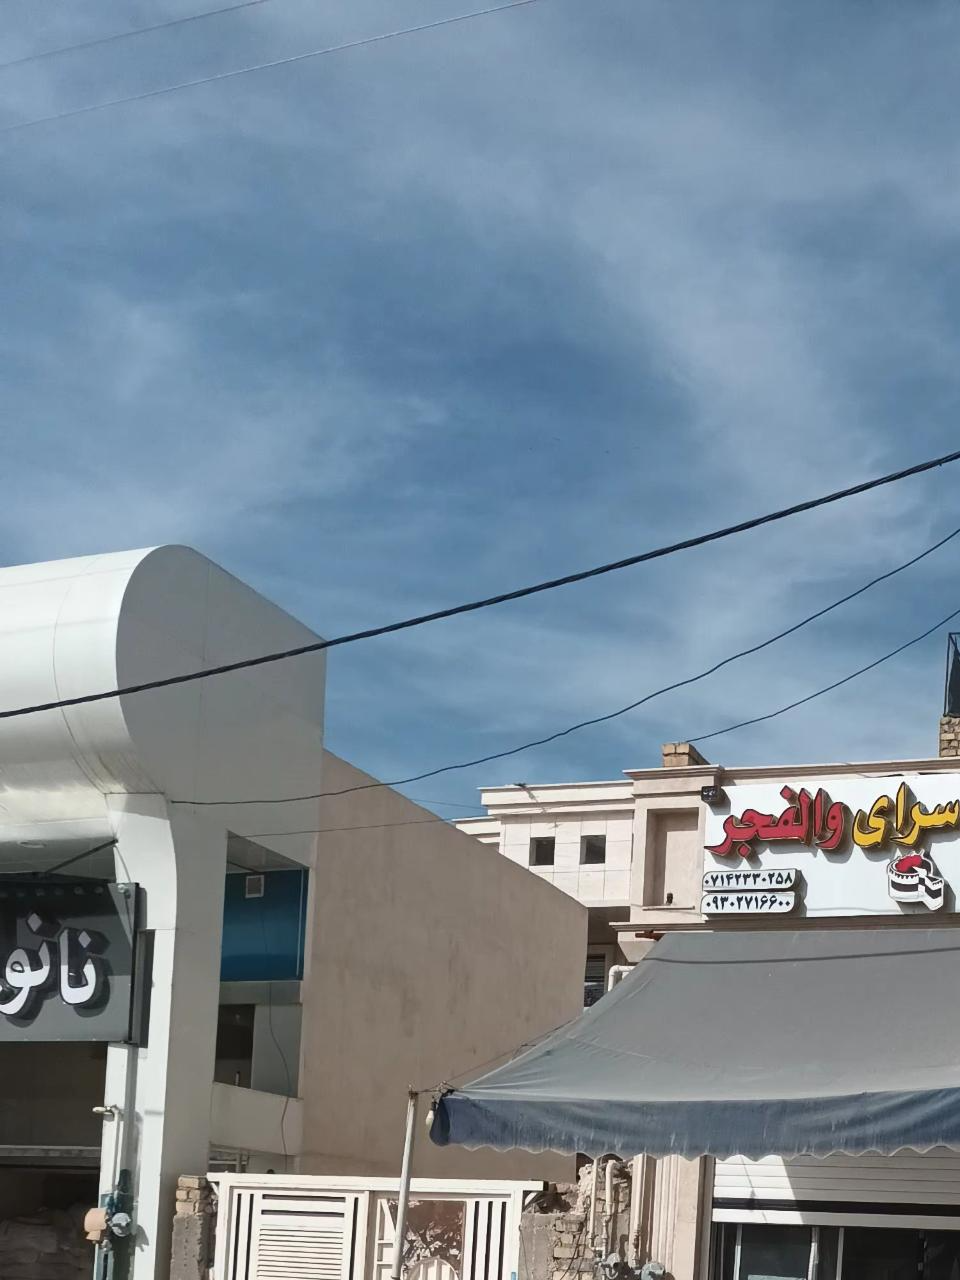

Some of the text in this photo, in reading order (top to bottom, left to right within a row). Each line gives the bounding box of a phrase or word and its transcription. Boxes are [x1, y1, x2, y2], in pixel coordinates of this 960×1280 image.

[704, 785, 844, 858] والفجر
[852, 781, 960, 847] سرای
[0, 912, 97, 1015] نانو
